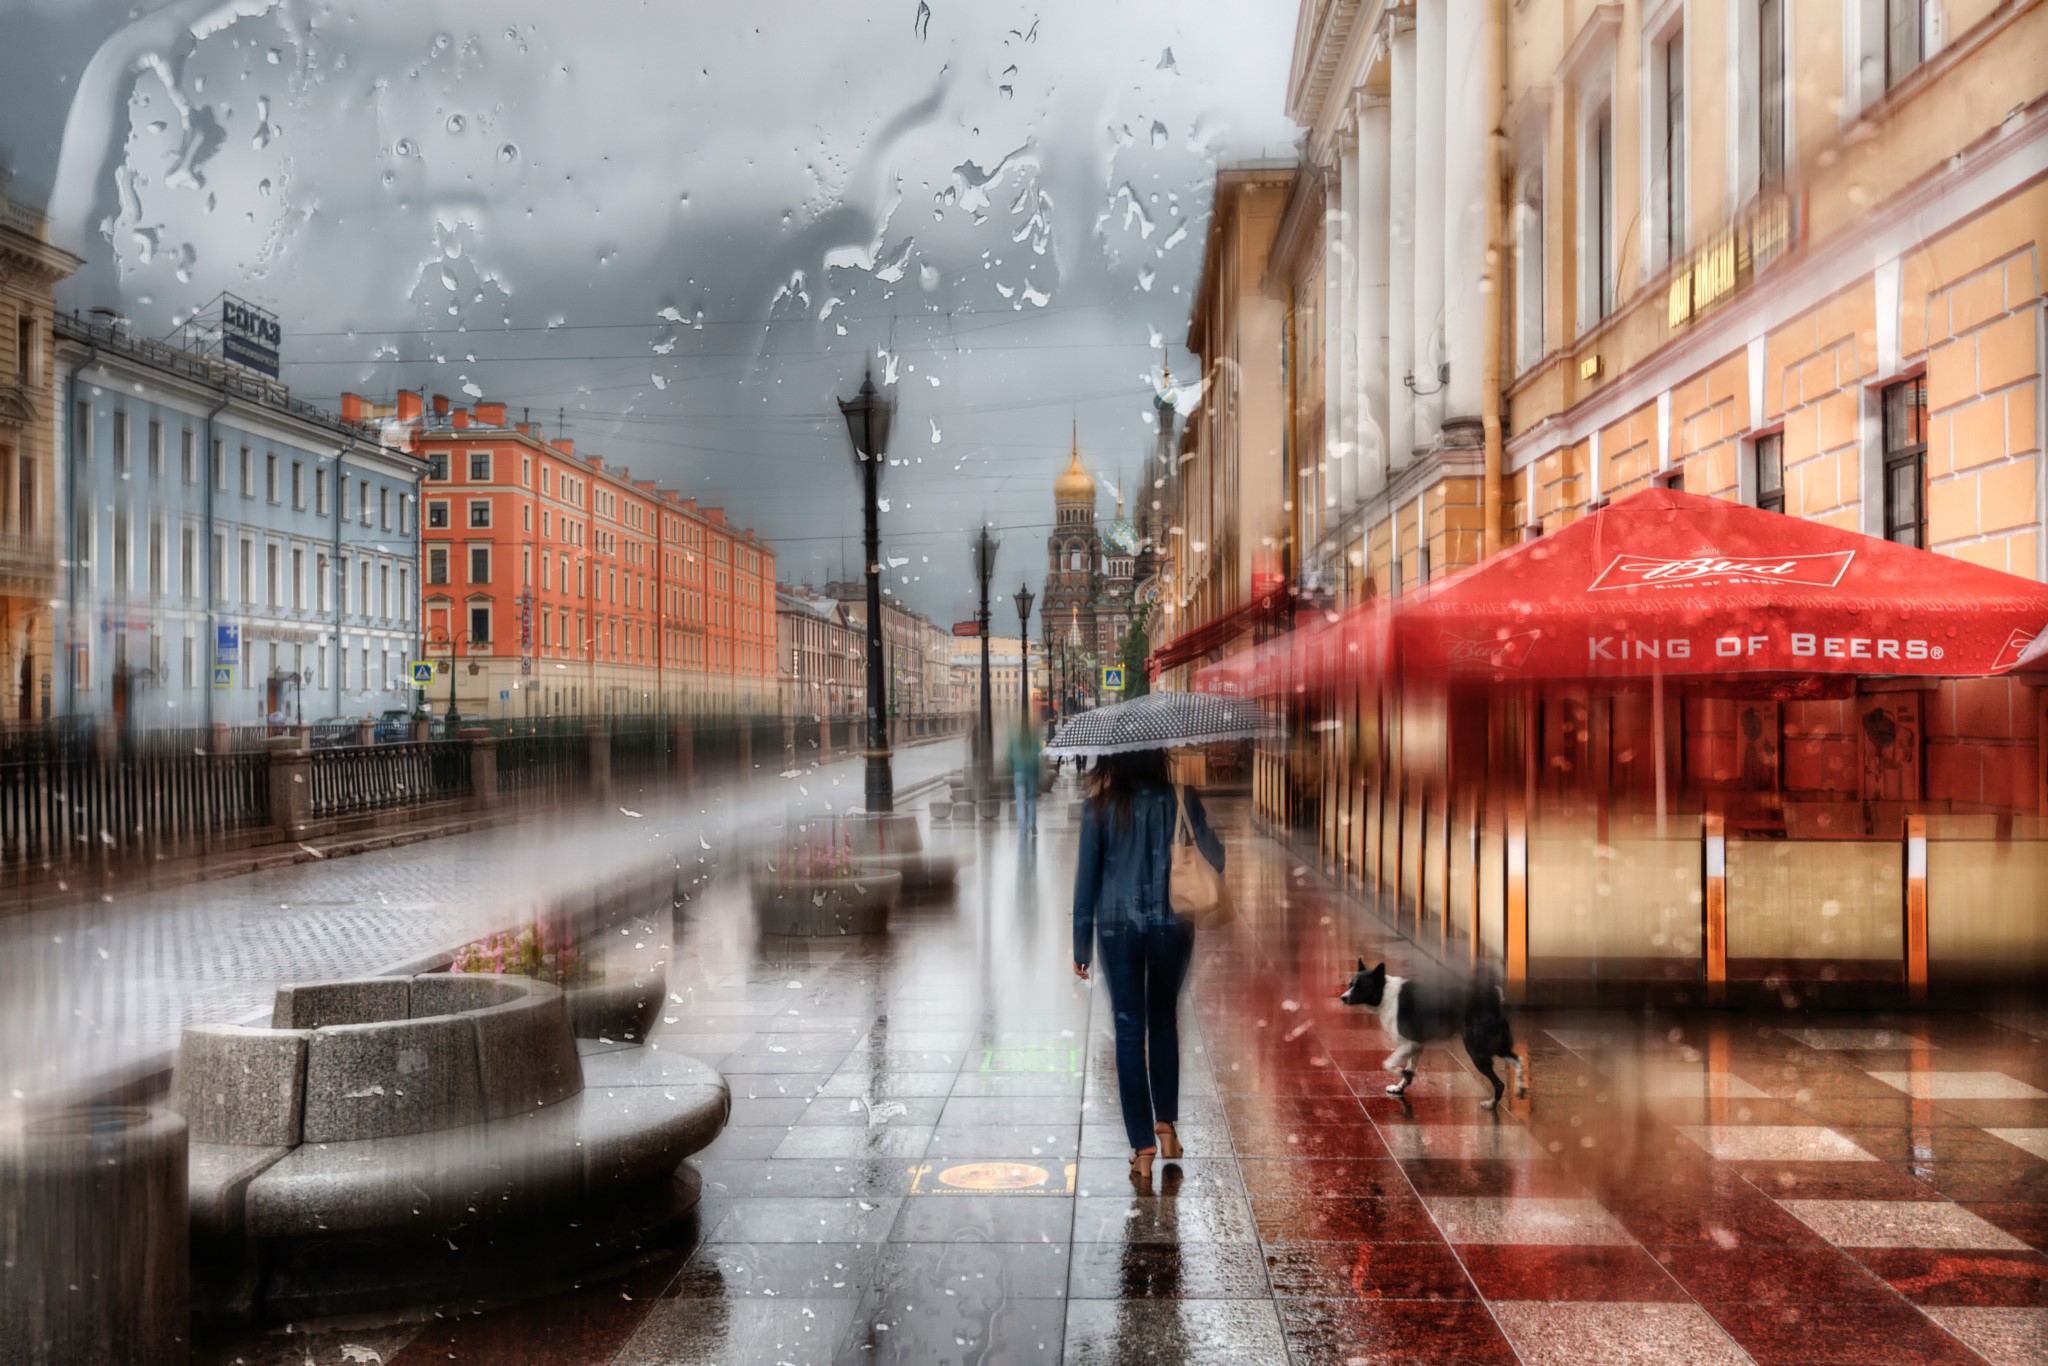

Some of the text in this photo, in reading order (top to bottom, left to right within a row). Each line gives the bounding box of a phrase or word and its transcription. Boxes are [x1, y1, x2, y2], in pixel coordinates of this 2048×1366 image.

[223, 300, 281, 345] СОГАЗ
[1619, 557, 1798, 579] Bud
[1428, 601, 1556, 616] ЧРЕЗМЕРОЕ
[1559, 595, 1711, 615] УПОТРЕБЛЕНИЕ
[1588, 636, 1691, 660] KING
[1715, 635, 1769, 657] OF
